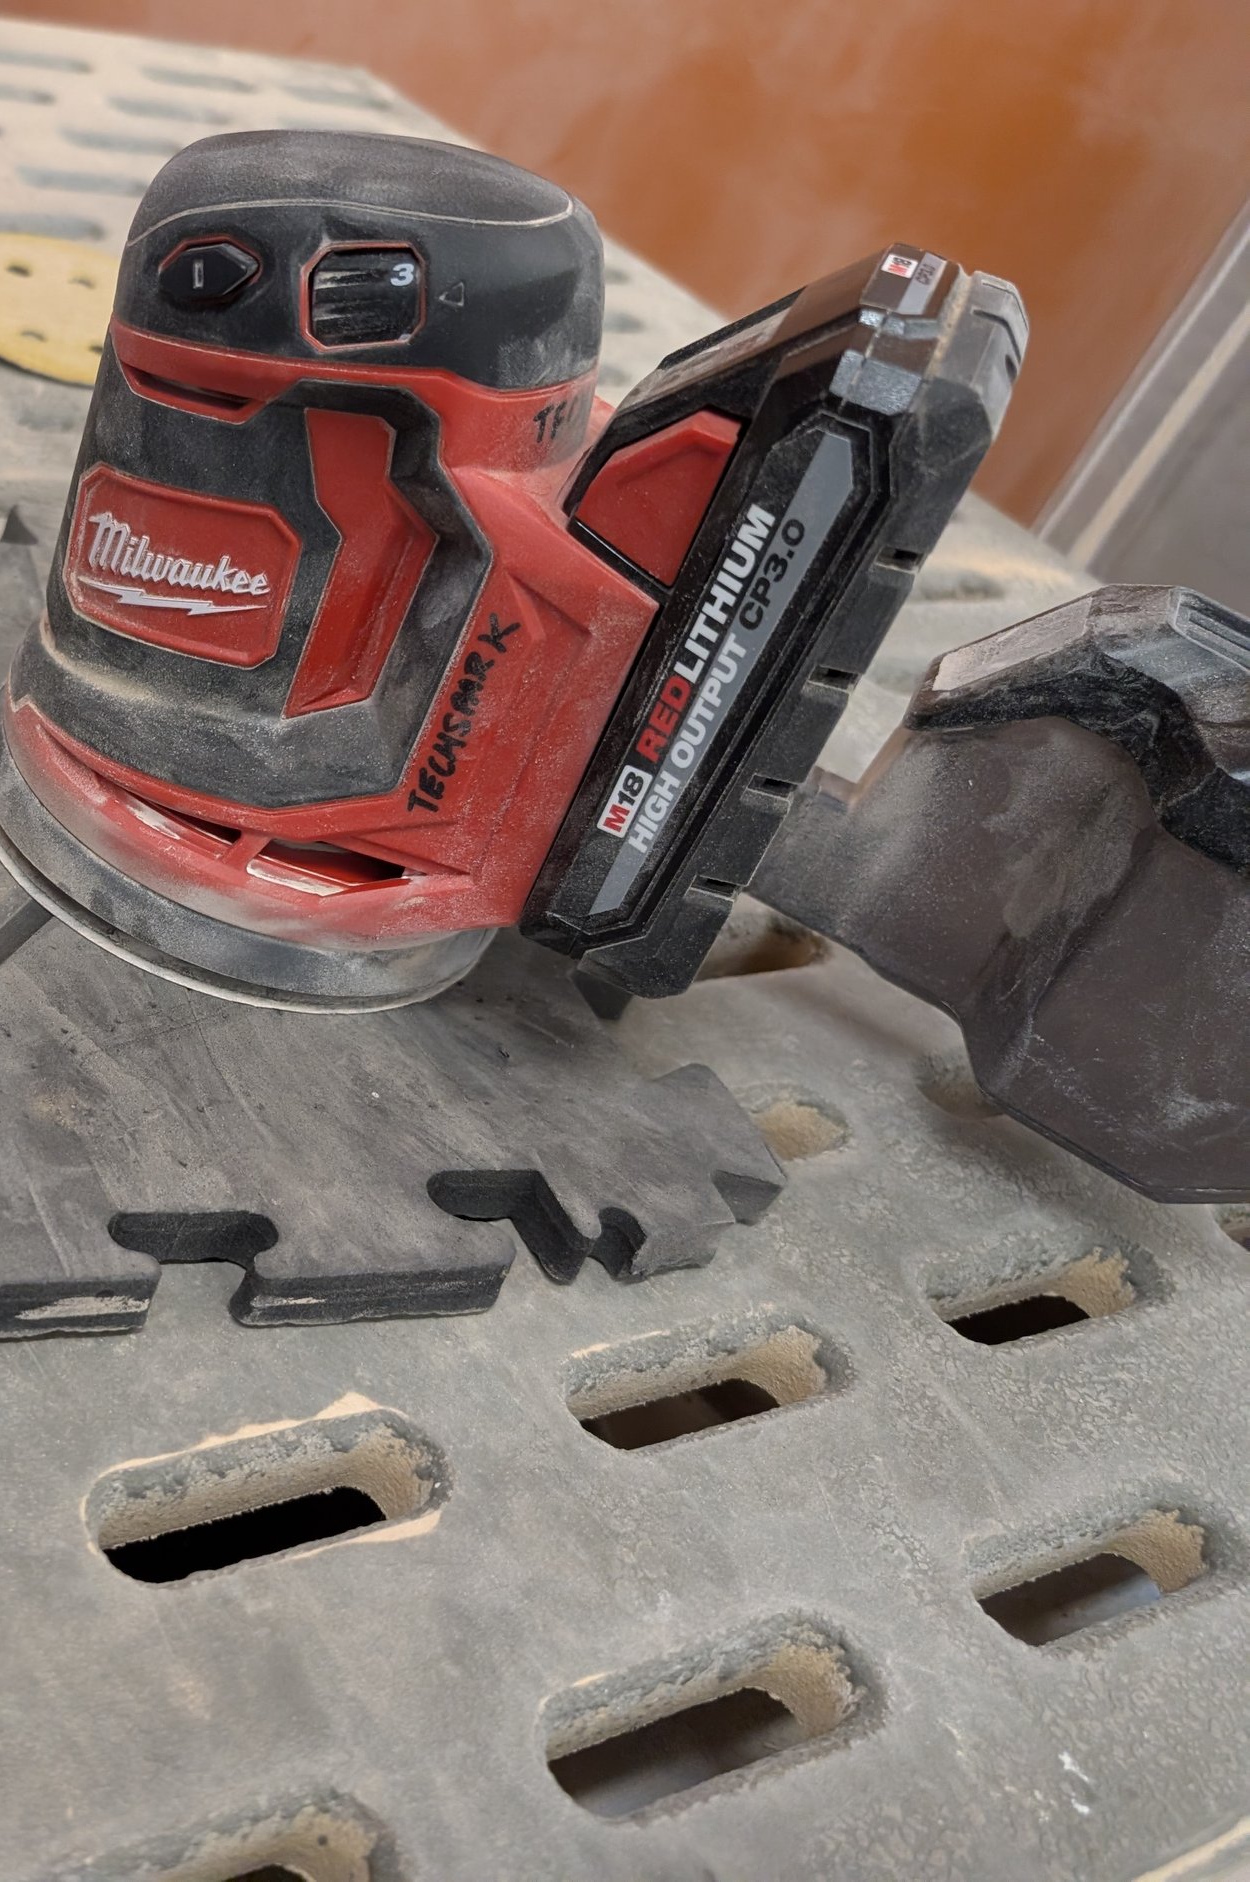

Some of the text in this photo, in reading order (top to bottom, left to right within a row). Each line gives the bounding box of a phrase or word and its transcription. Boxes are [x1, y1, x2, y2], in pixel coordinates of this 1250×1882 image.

[391, 263, 414, 286] 3
[88, 511, 270, 596] Milwaukee
[603, 503, 776, 832] M18 REDLITHIUM
[628, 519, 805, 853] HIGH OUTPUT CP3.0
